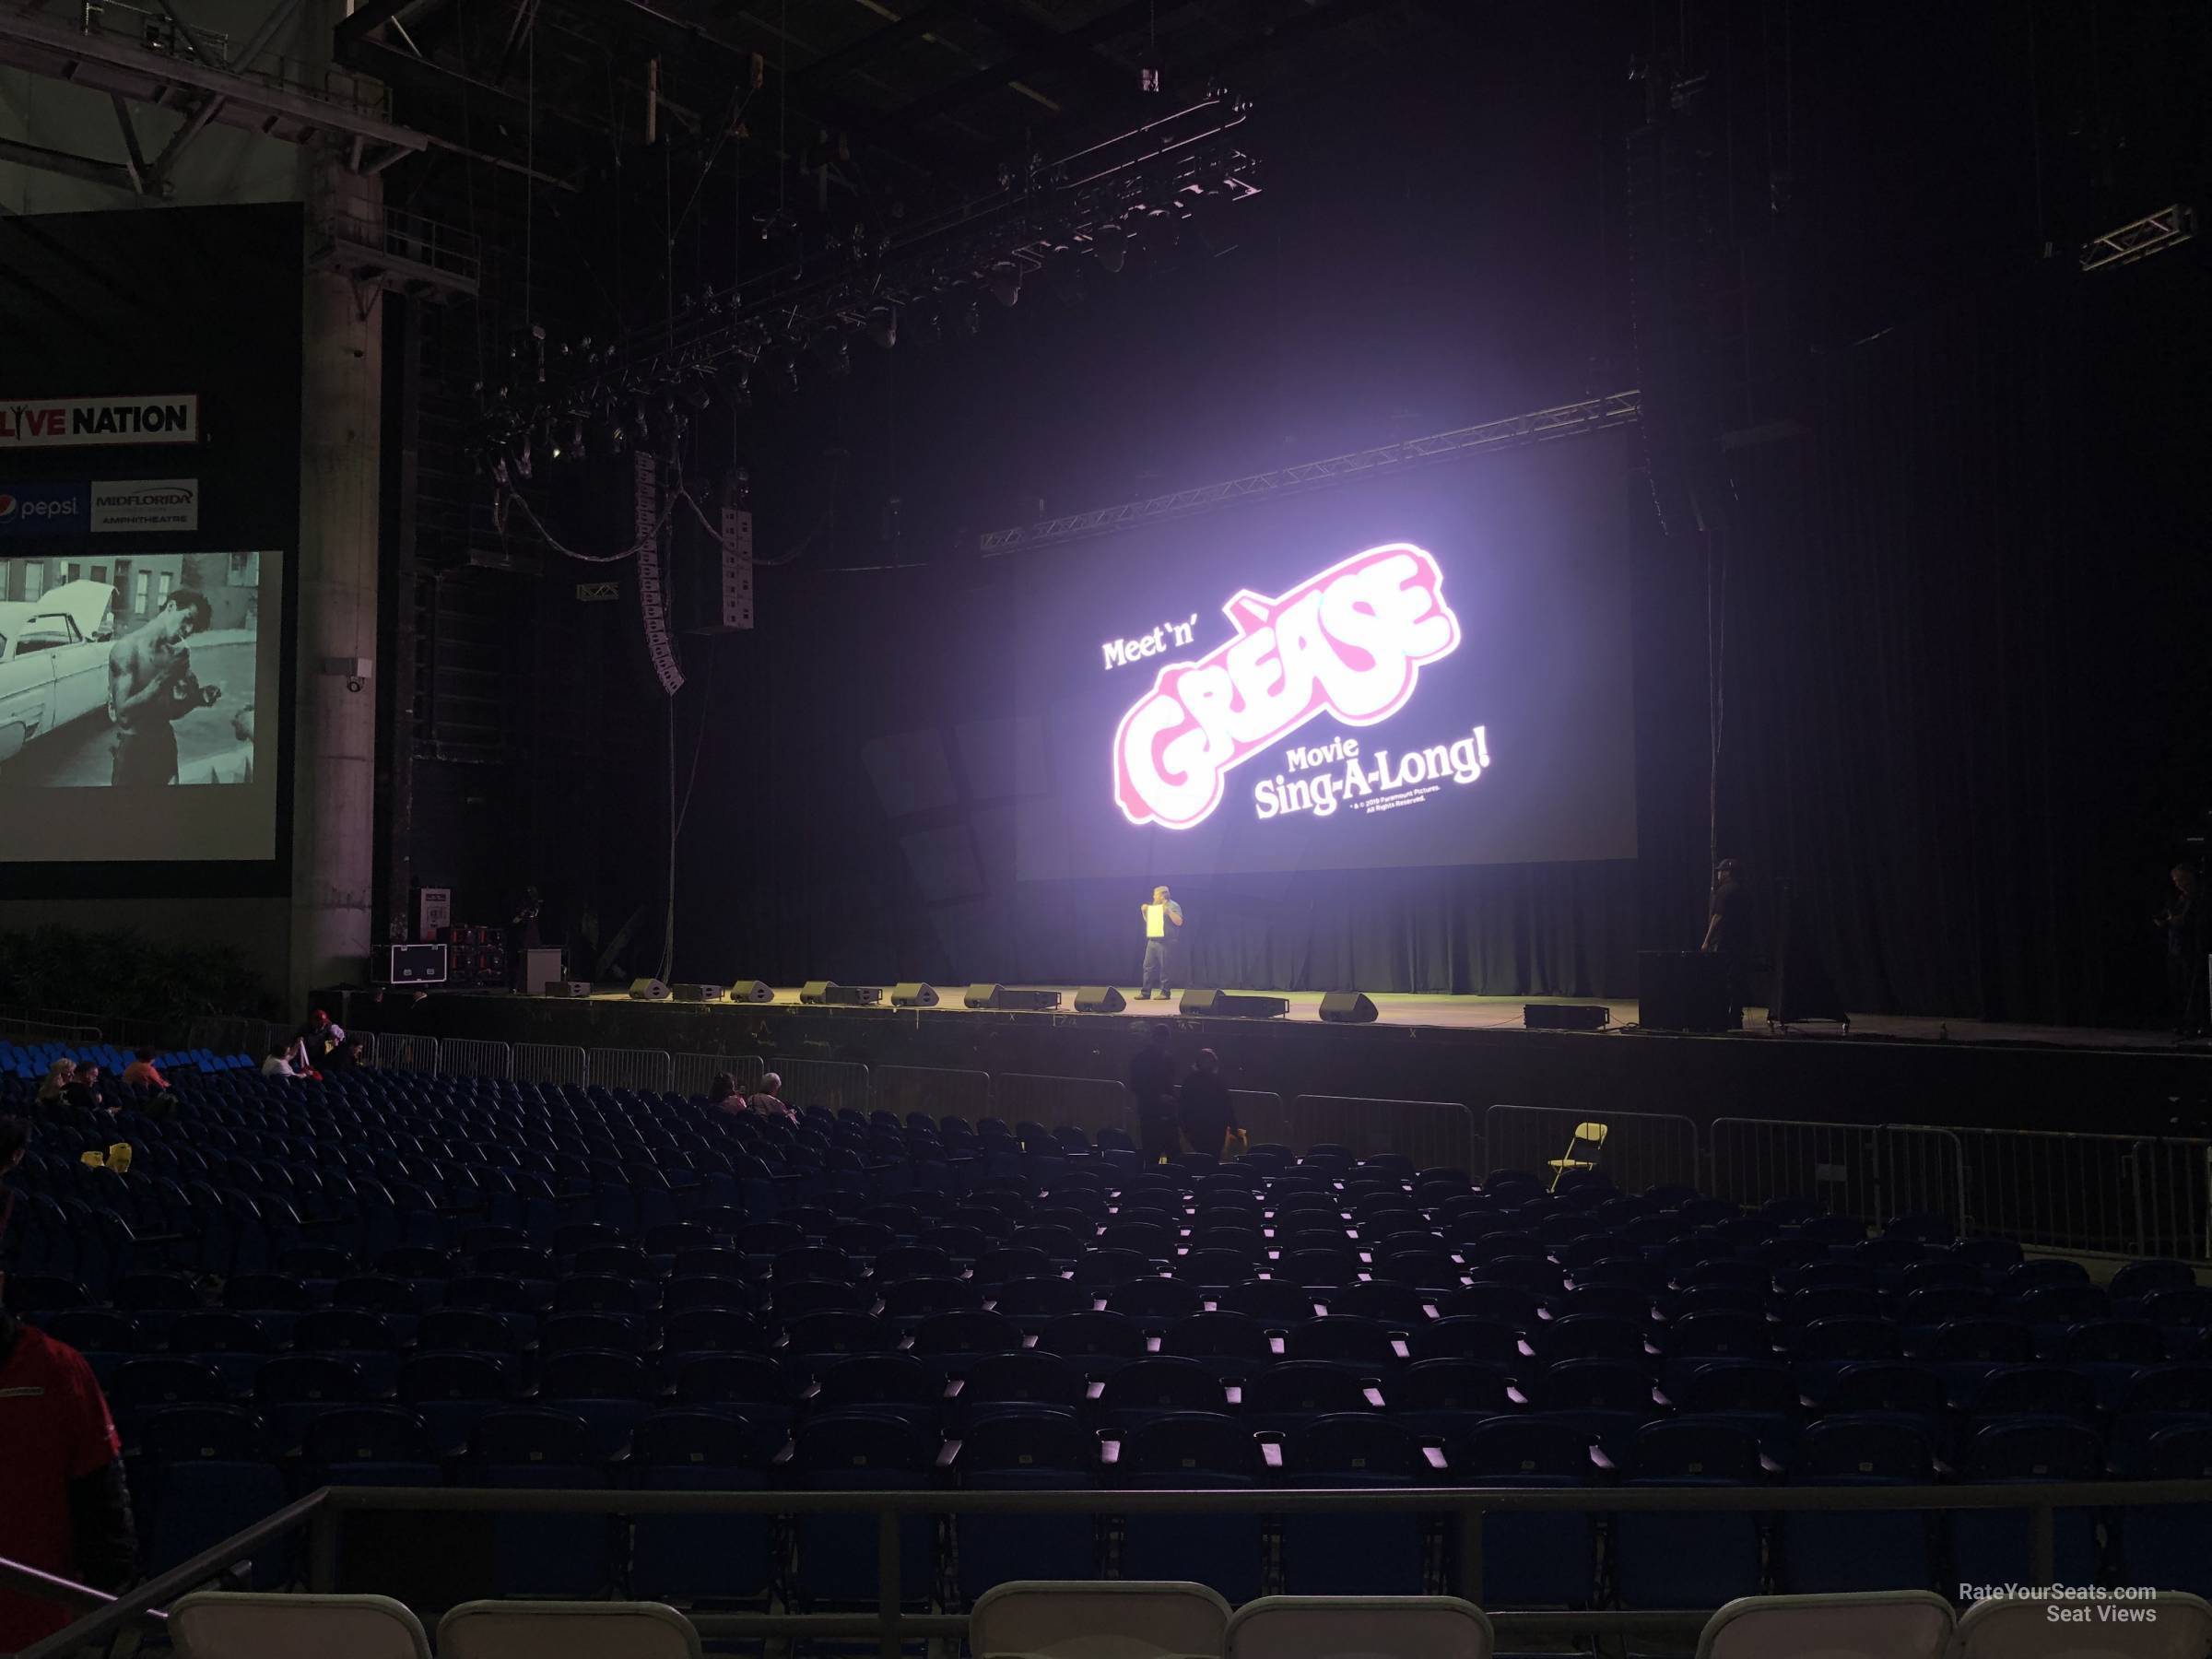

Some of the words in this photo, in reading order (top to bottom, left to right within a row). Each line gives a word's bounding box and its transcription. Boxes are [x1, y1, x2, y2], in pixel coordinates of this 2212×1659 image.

[0, 406, 65, 441] LIVE
[73, 406, 187, 434] NATION
[21, 497, 77, 520] pepsi
[96, 494, 192, 507] MIDFLORIDA
[102, 515, 188, 524] AMPHITHEATRE
[1101, 629, 1166, 670] Meet
[1120, 550, 1454, 827] GREASE
[1286, 736, 1359, 772] Movie
[1254, 725, 1490, 819] Sing-A-Long!
